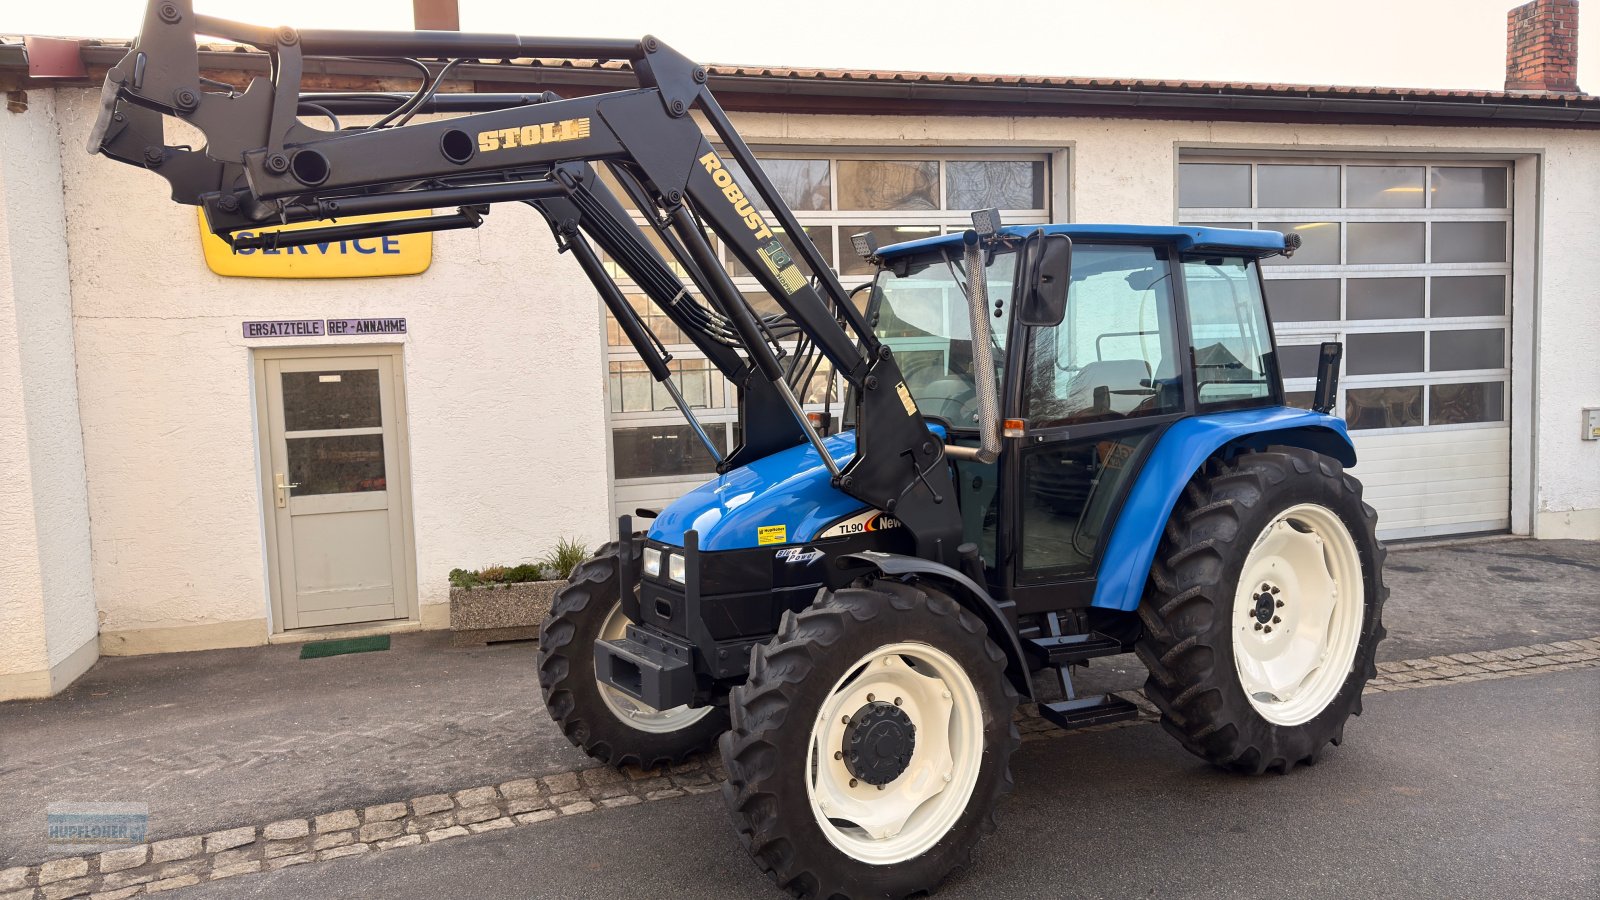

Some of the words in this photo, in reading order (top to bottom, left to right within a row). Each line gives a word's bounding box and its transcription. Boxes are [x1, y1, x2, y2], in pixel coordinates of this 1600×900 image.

[478, 118, 588, 152] STOLL
[699, 152, 773, 240] ROBUST
[237, 231, 400, 255] SVICE
[249, 322, 319, 336] ERSATZTEILE
[839, 522, 863, 534] TL90
[778, 549, 798, 557] Blue
[789, 553, 816, 561] Power
